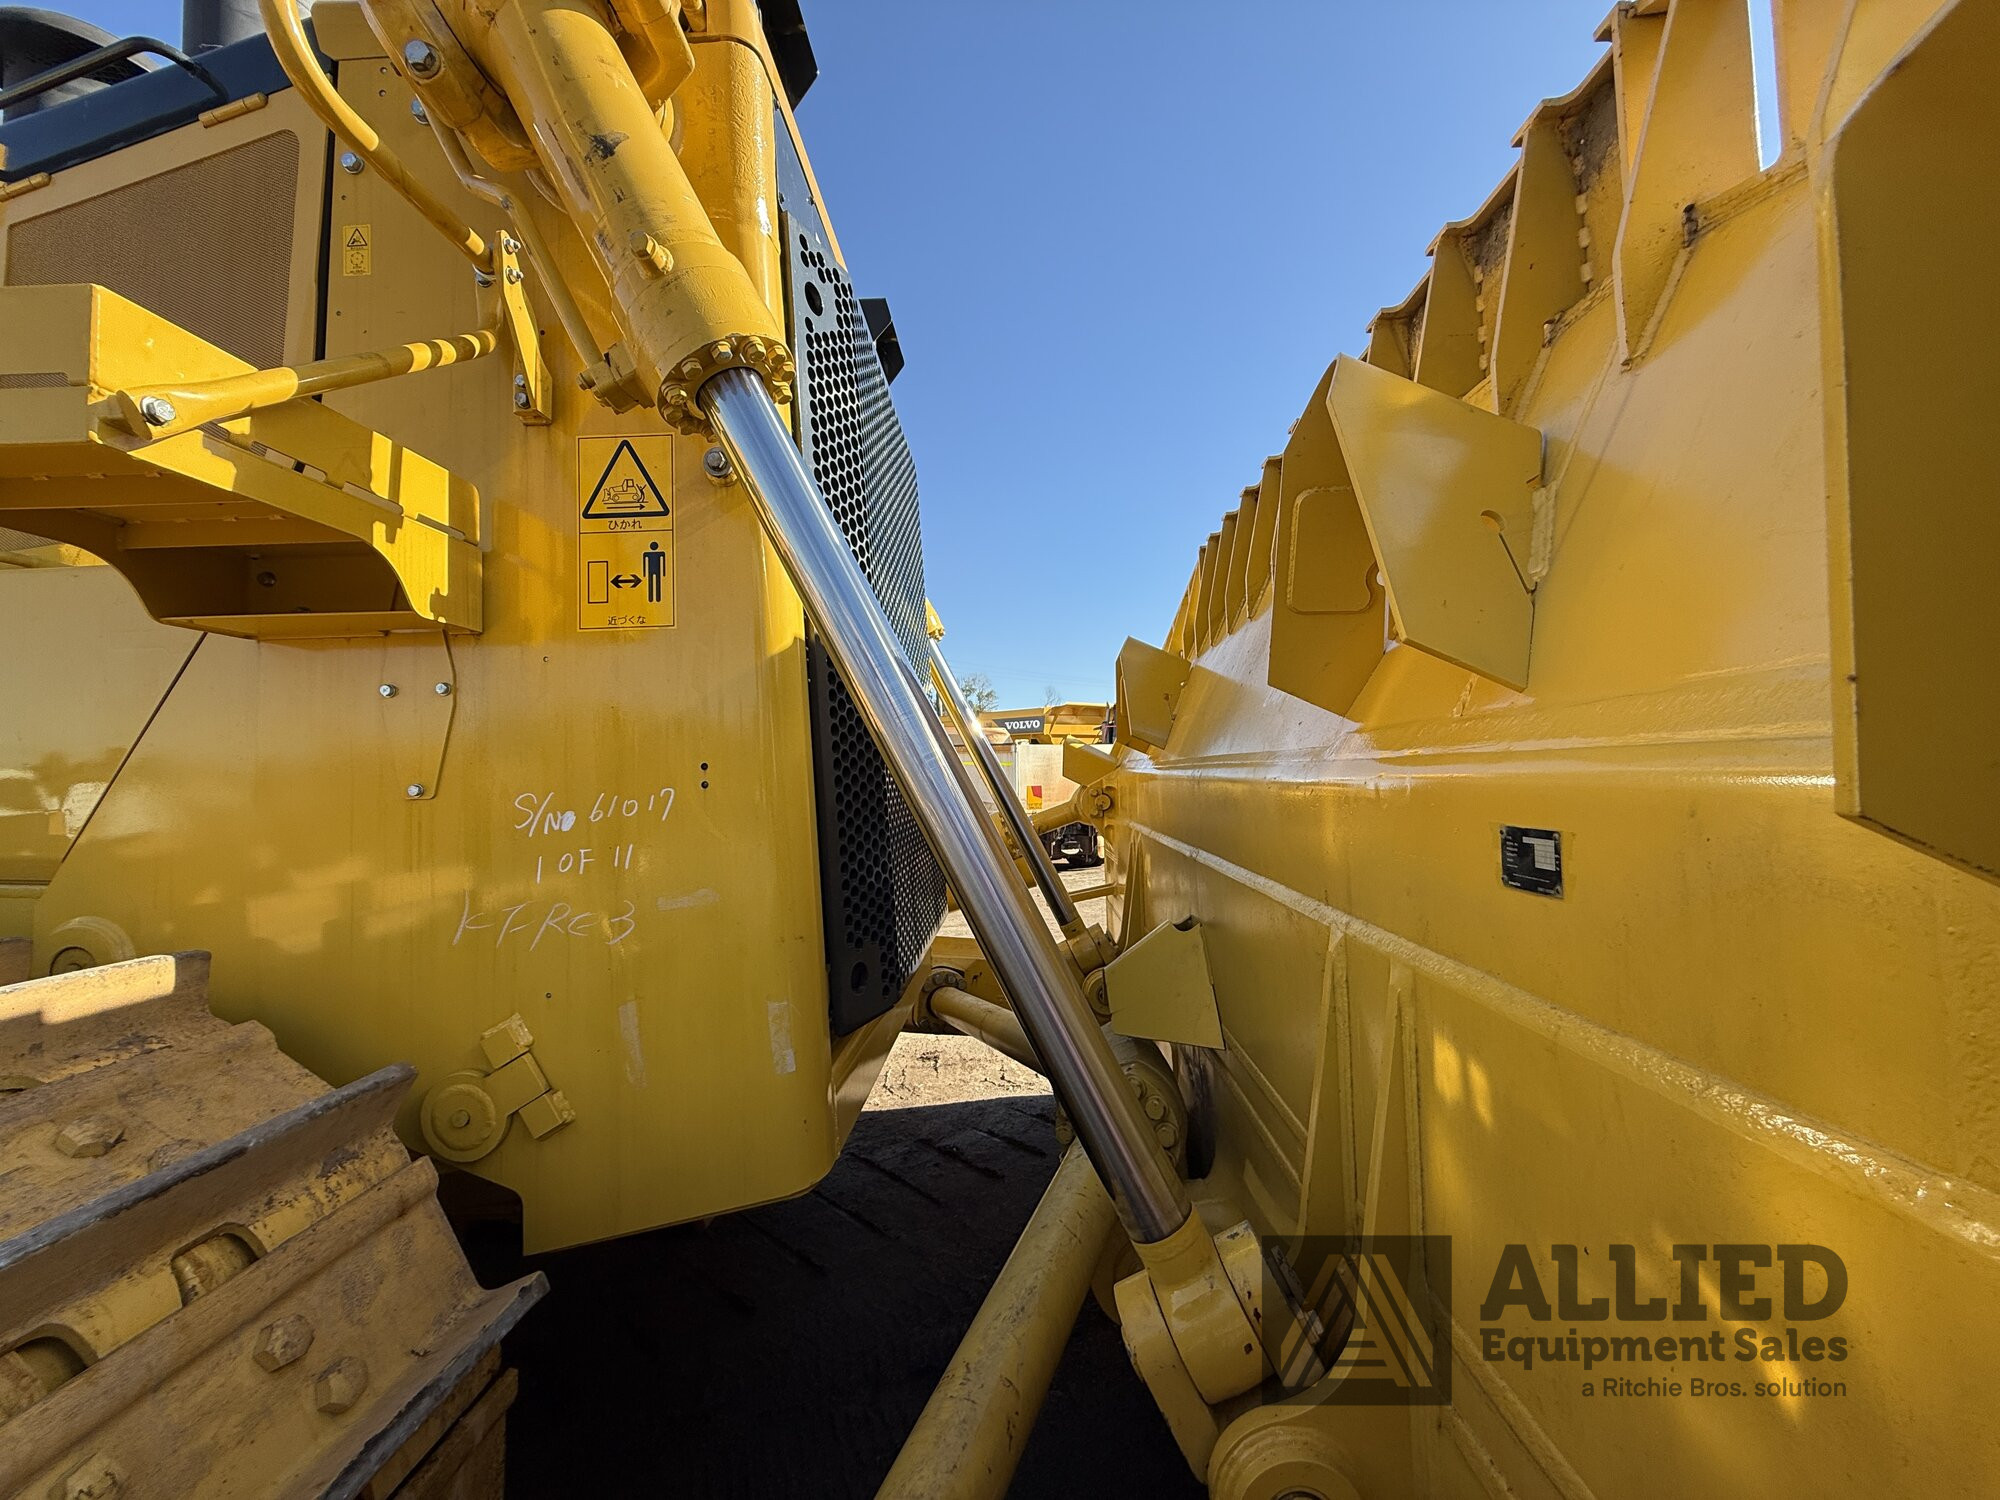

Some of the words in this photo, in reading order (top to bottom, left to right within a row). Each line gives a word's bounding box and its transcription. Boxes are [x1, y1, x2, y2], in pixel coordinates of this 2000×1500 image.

[608, 519, 642, 530] ひかれ
[608, 615, 646, 625] 近づくな
[1004, 719, 1040, 730] VOLVO
[589, 788, 675, 822] 61017
